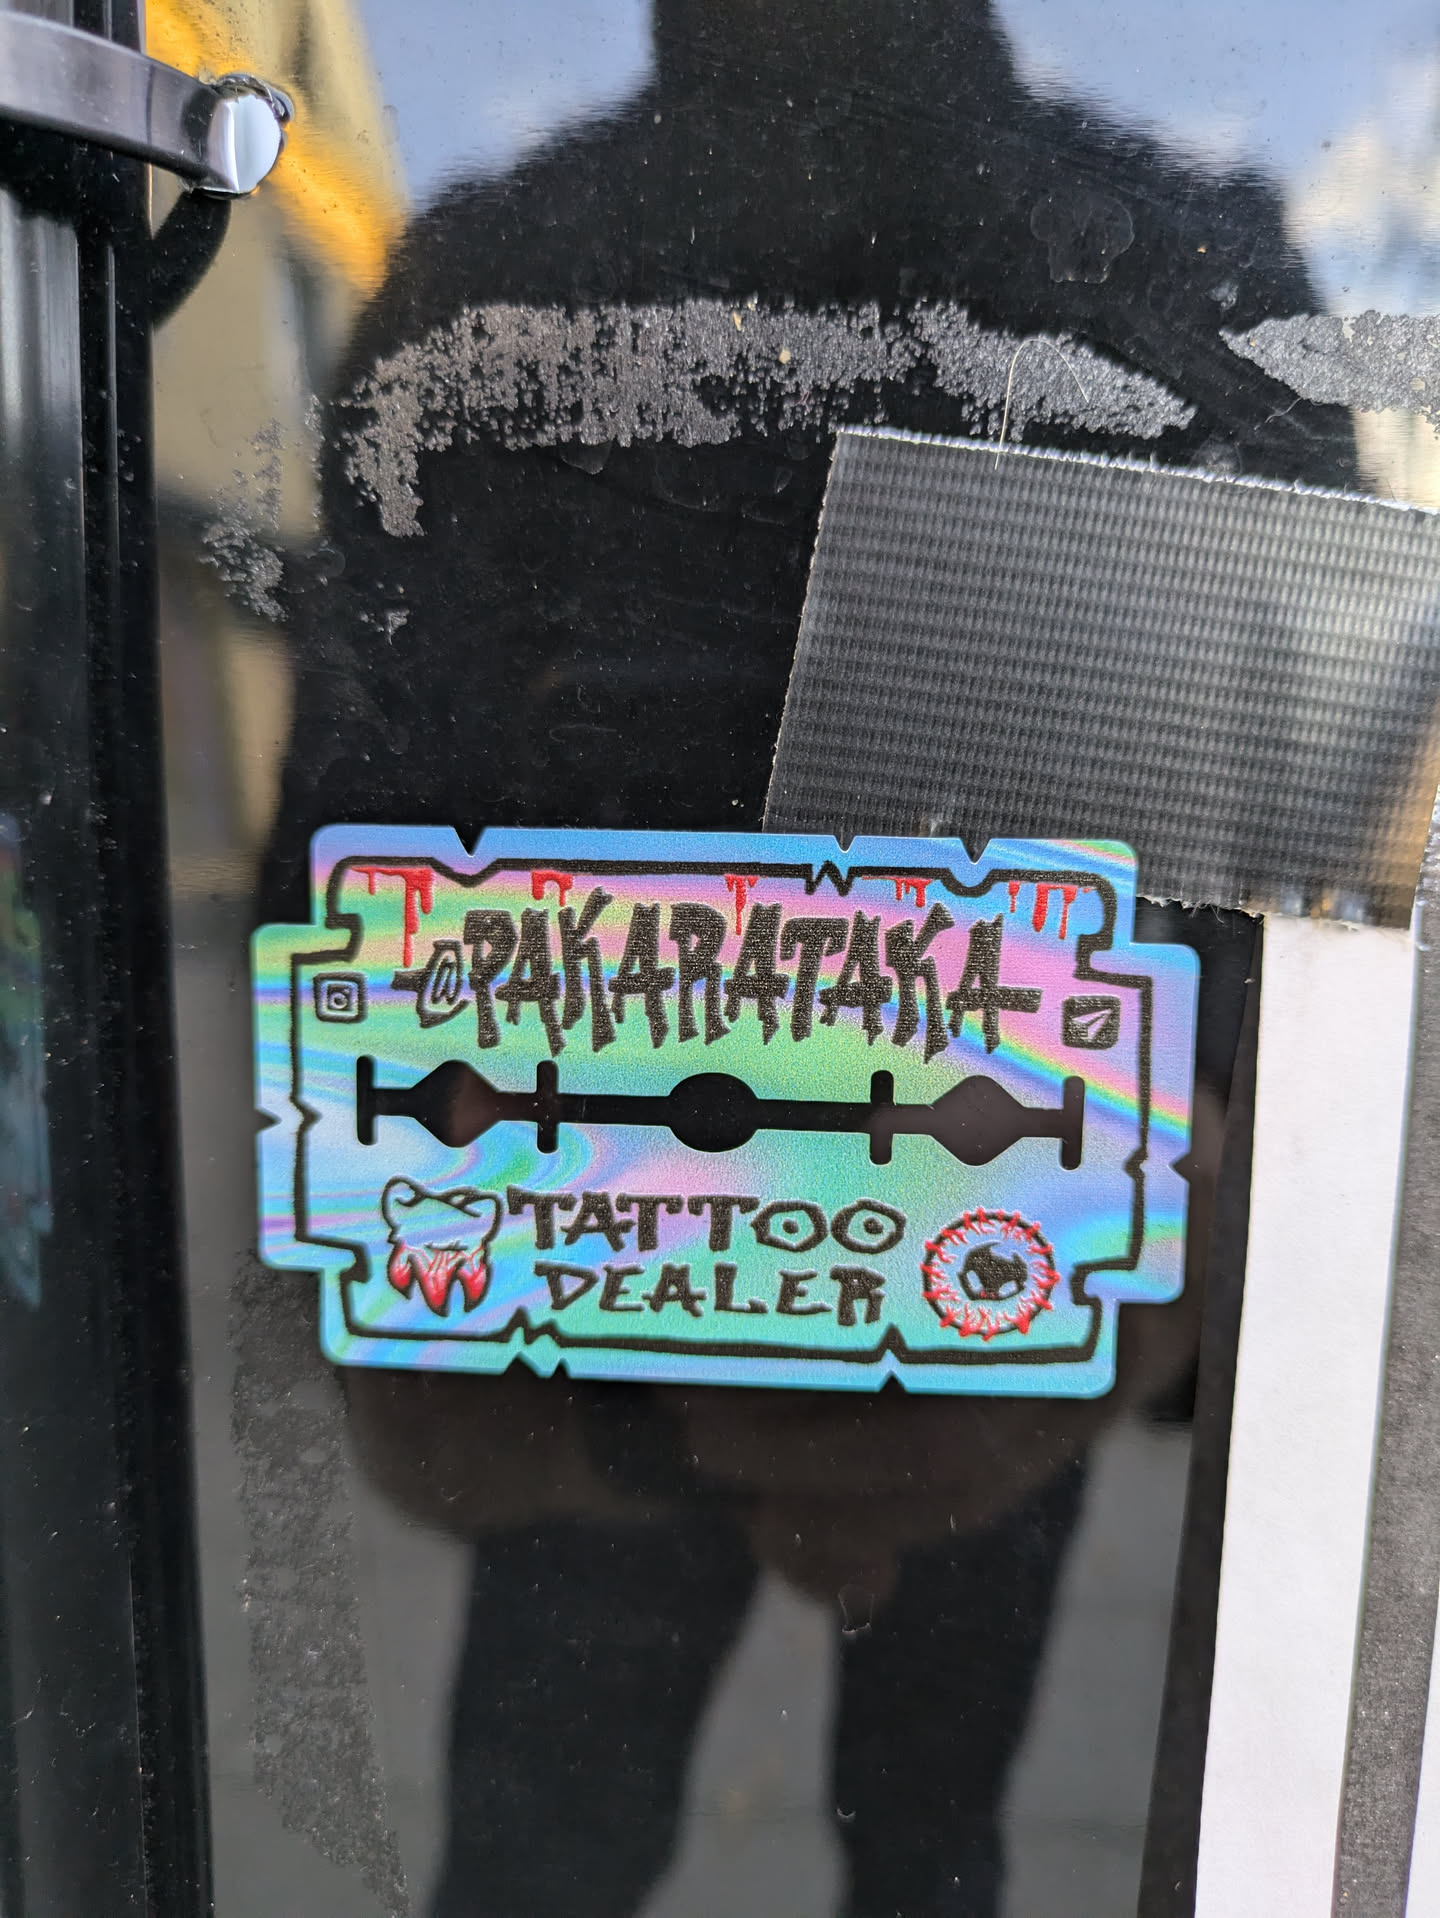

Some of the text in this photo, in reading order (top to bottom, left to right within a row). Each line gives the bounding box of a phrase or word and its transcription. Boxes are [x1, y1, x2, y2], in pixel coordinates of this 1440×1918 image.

[391, 886, 1042, 1064] @PAKARATAKA
[506, 1185, 907, 1254] TATTOO
[533, 1261, 887, 1327] DEALER
